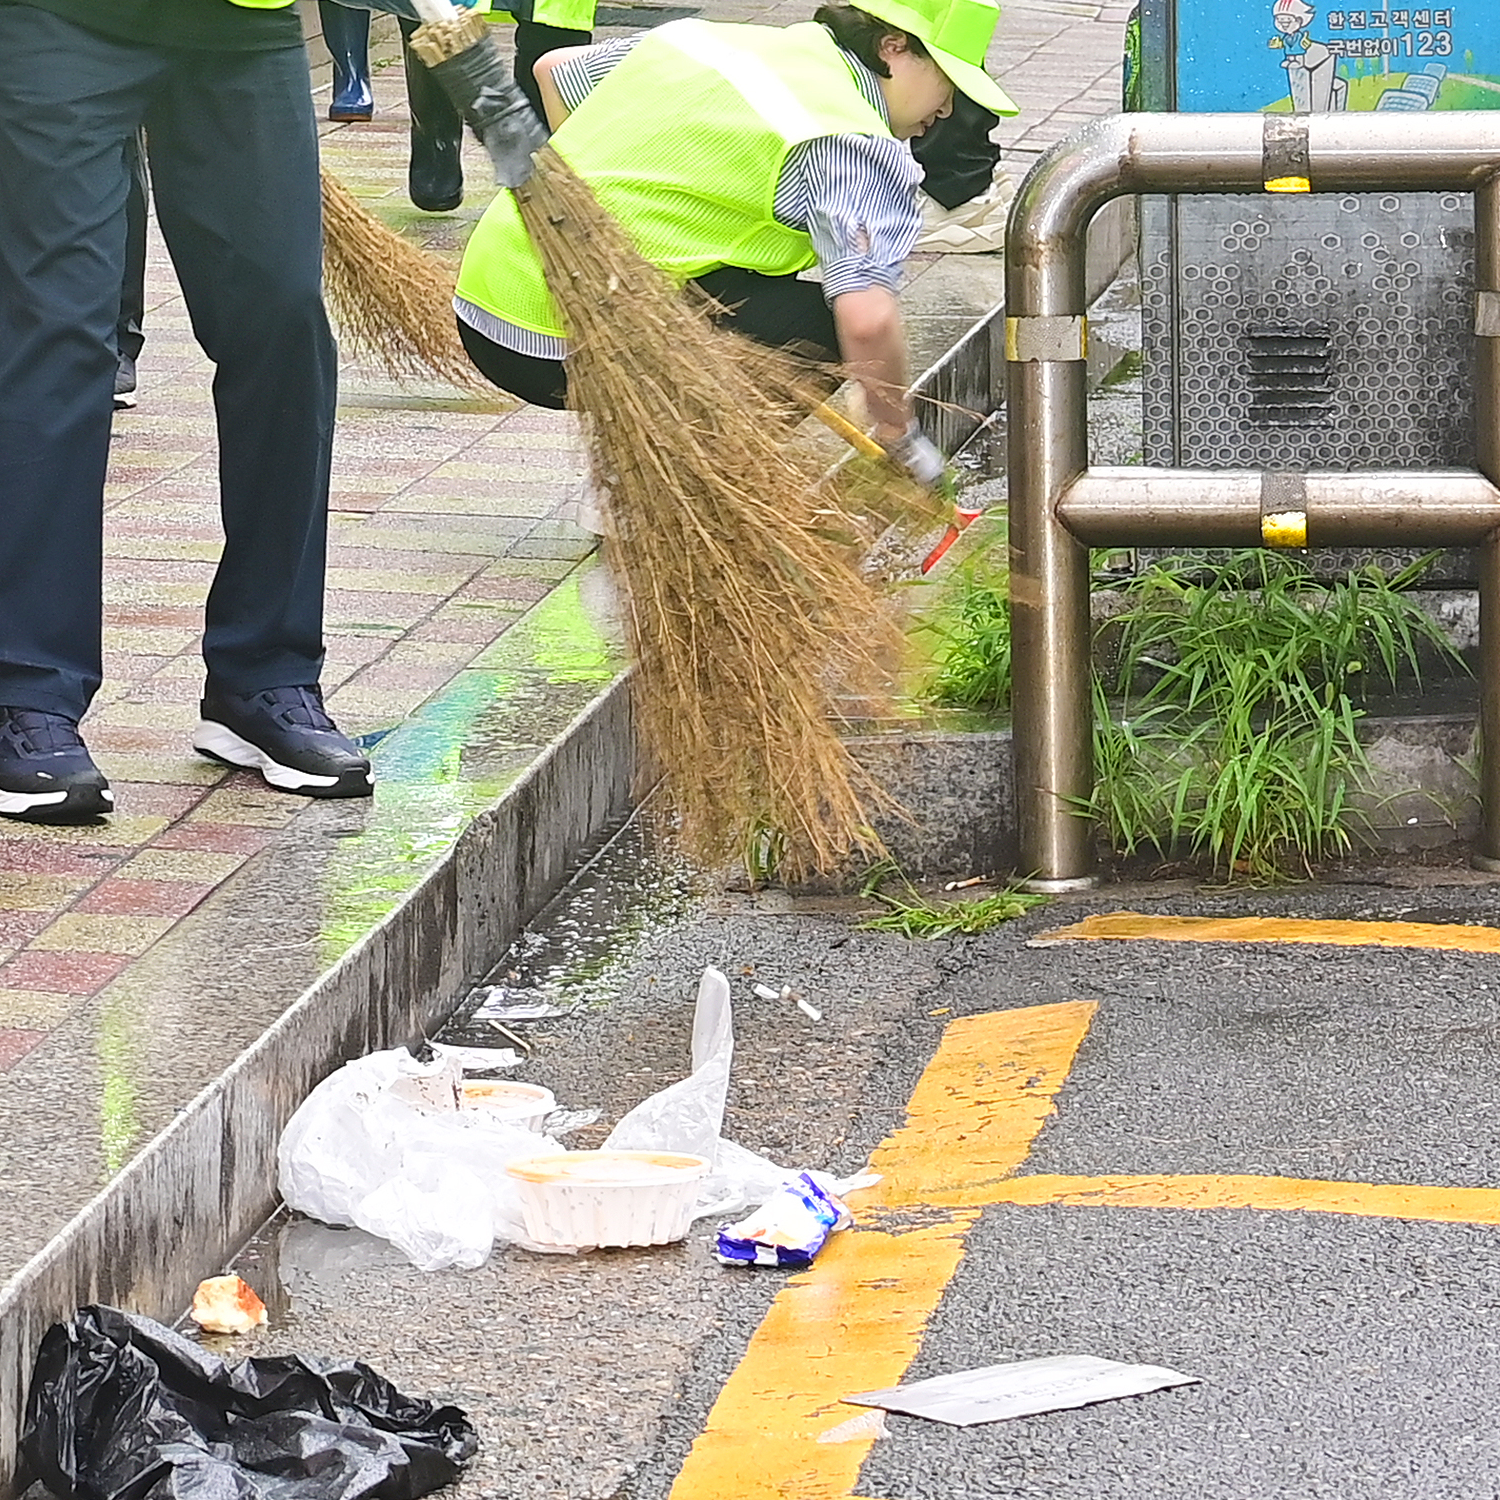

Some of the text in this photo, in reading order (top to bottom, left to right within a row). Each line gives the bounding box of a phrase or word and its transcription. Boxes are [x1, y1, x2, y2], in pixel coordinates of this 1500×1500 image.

[1327, 9, 1452, 30] 한전고객센터
[1327, 31, 1453, 57] 국번없이 123
